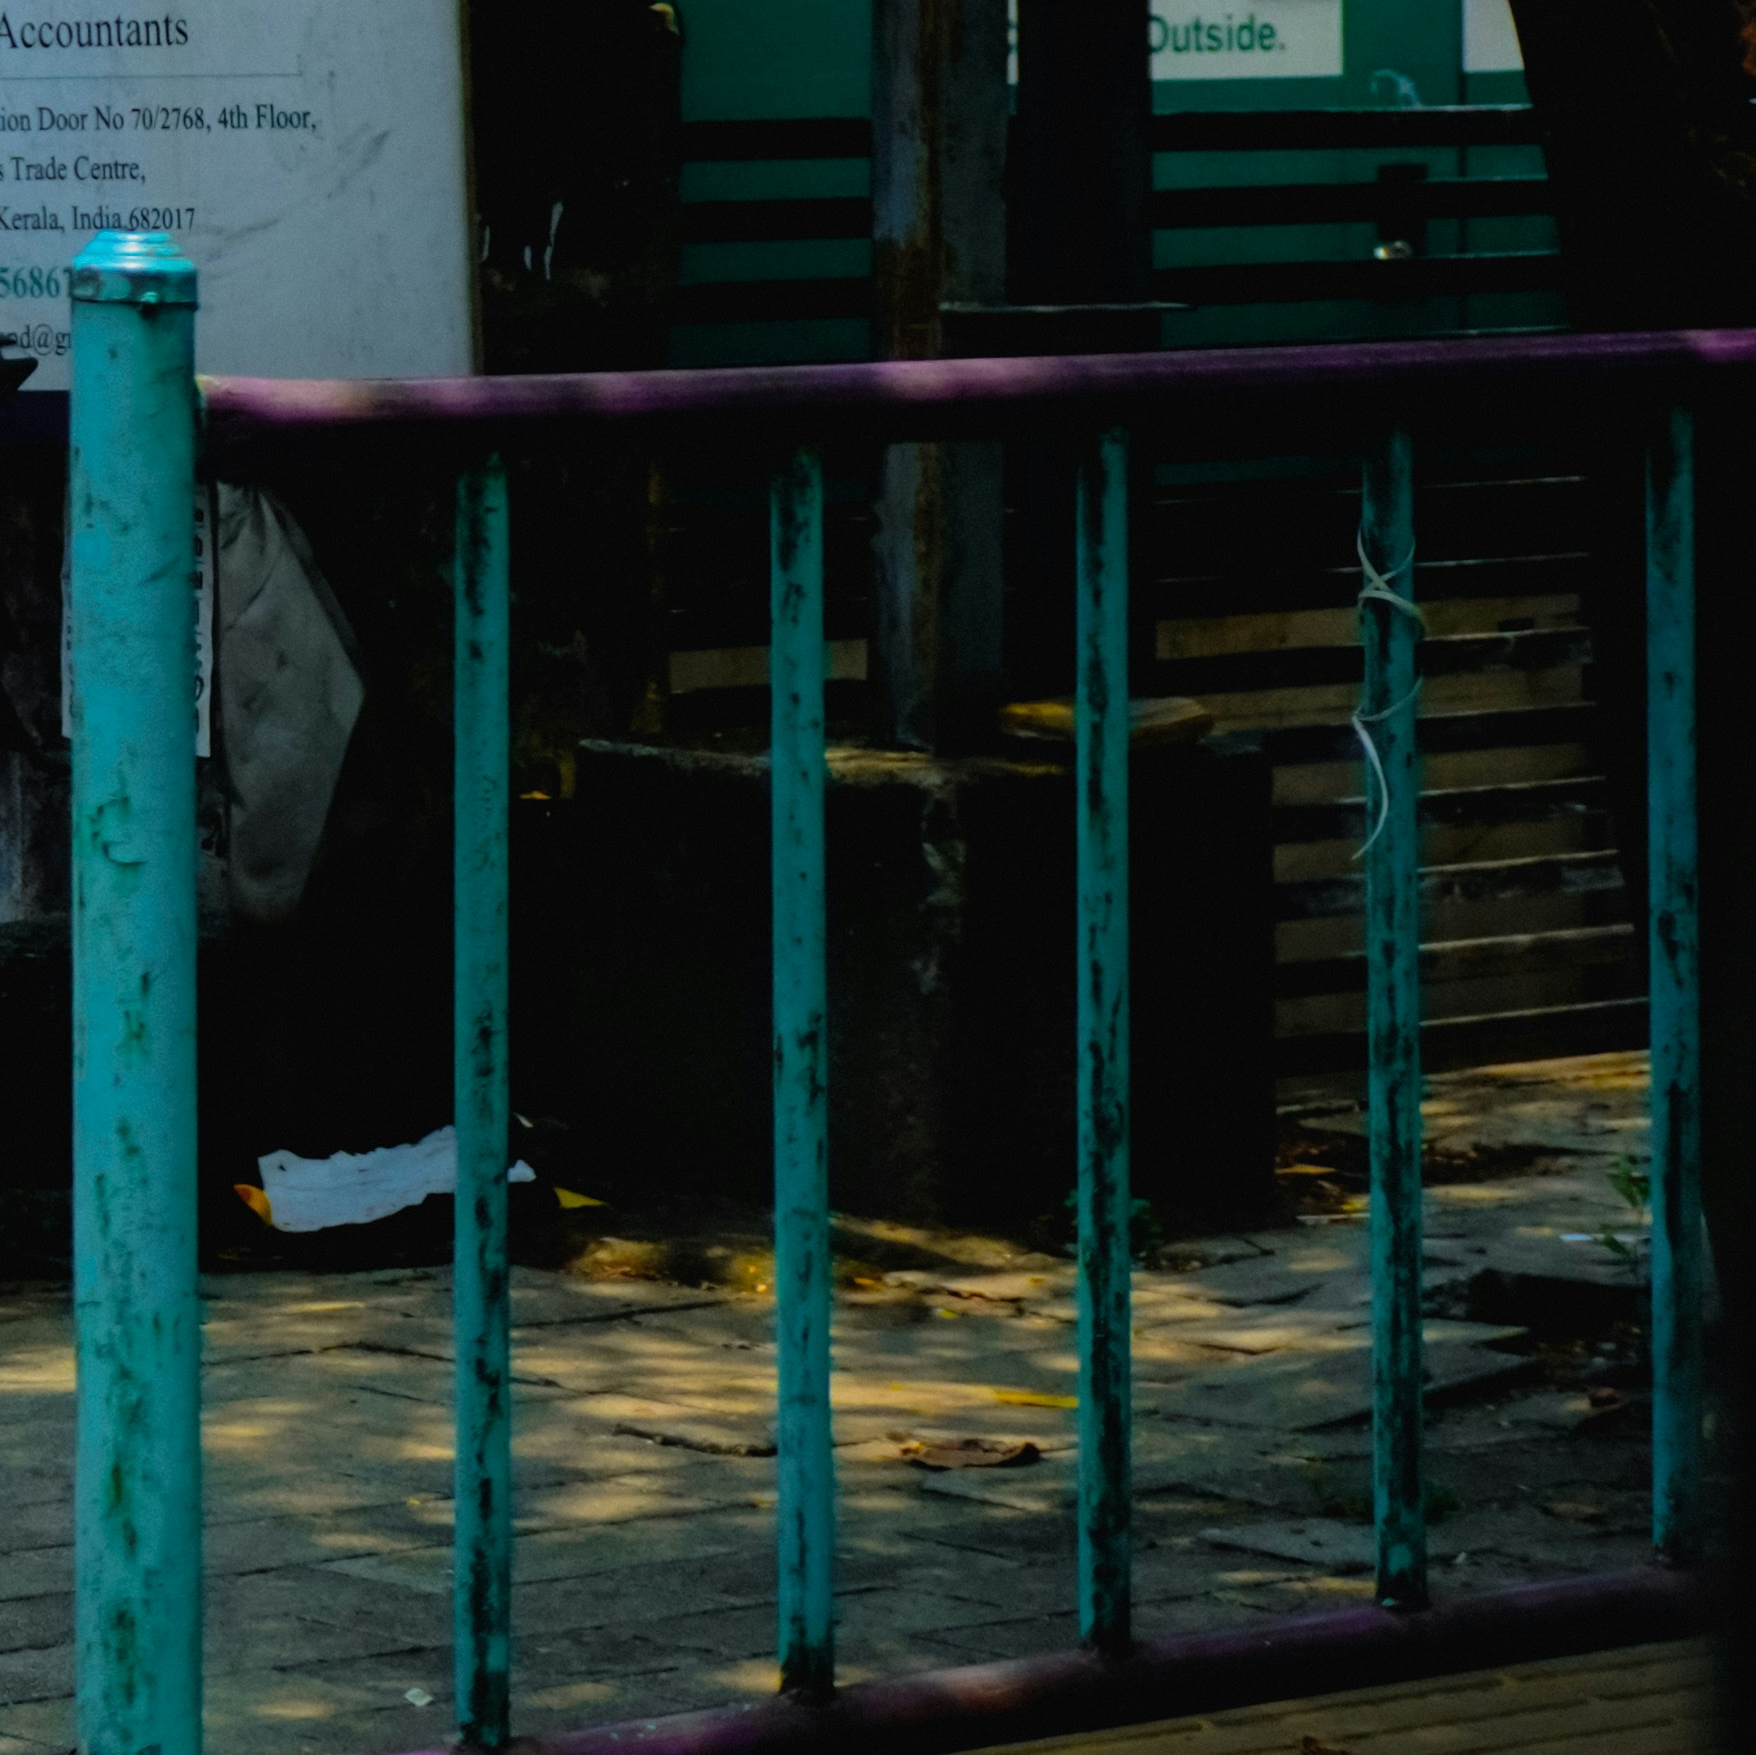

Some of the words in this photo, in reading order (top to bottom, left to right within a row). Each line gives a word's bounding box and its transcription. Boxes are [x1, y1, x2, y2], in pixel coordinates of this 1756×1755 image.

[38, 104, 89, 135] Door
[94, 104, 126, 134] No
[130, 103, 212, 137] 70/2768,
[218, 102, 251, 132] 4th
[254, 101, 318, 135] Floor,
[10, 155, 68, 184] Trade
[74, 155, 148, 187] Centre,
[128, 205, 197, 232] 682017
